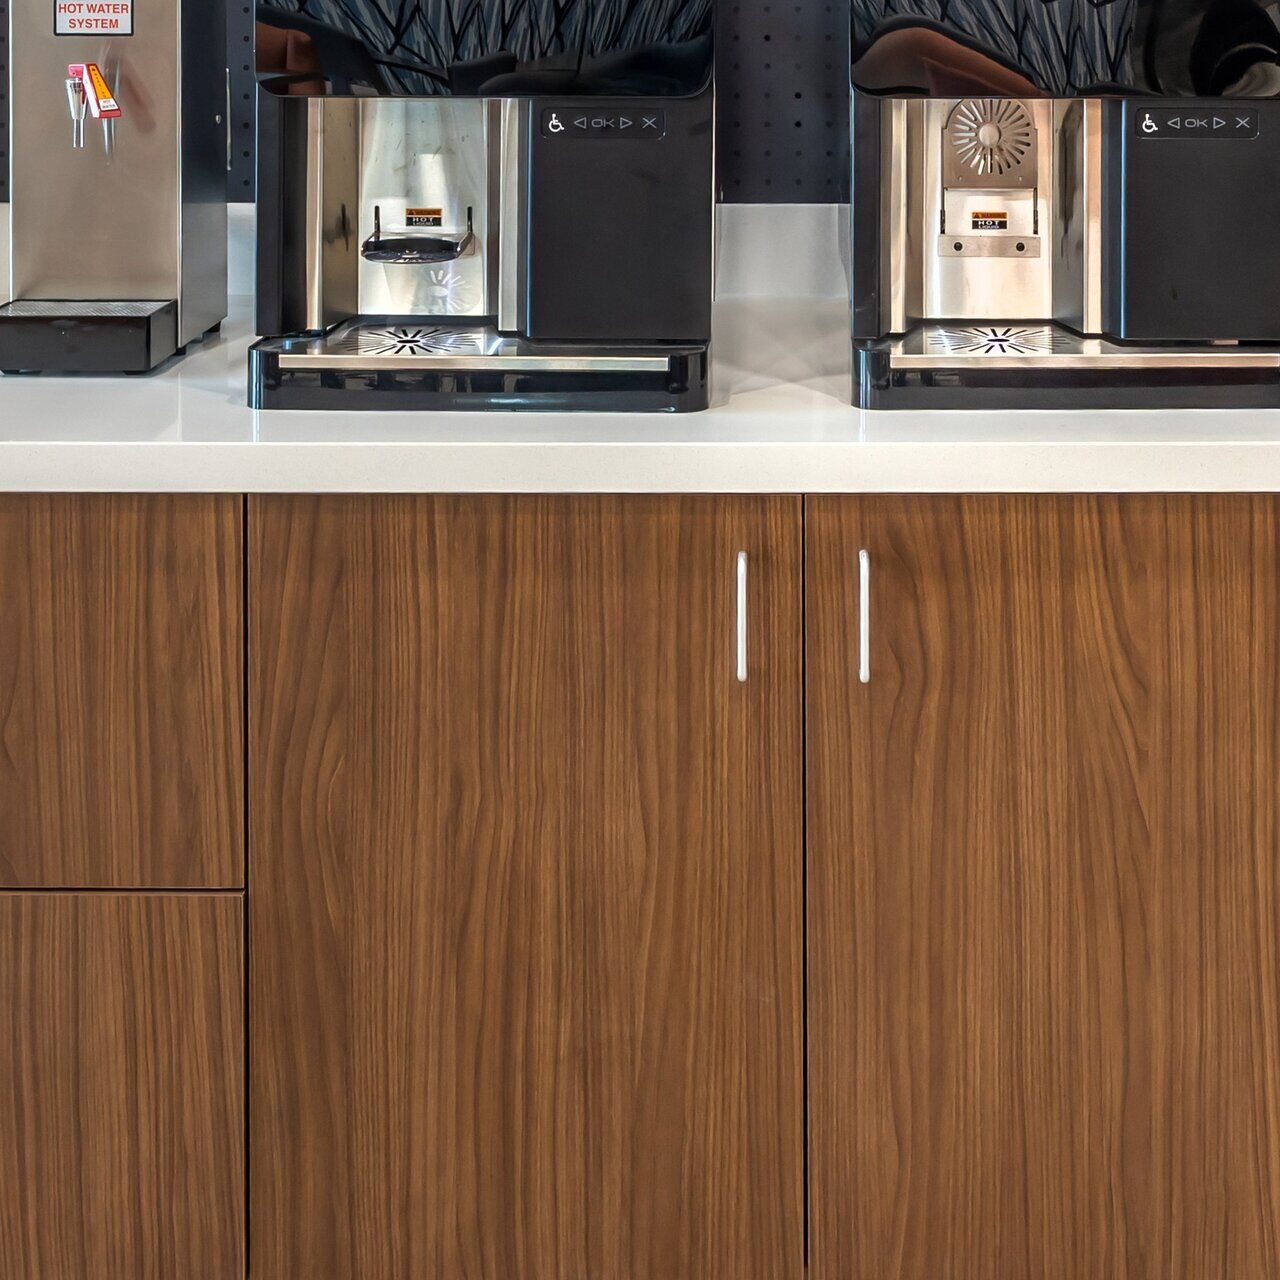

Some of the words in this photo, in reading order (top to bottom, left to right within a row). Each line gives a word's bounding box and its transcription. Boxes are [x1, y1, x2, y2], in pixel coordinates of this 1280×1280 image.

[58, 3, 84, 14] HOT
[86, 3, 129, 14] WATER
[68, 18, 119, 29] SYSTEM
[591, 118, 615, 128] OK
[1184, 118, 1208, 128] OK
